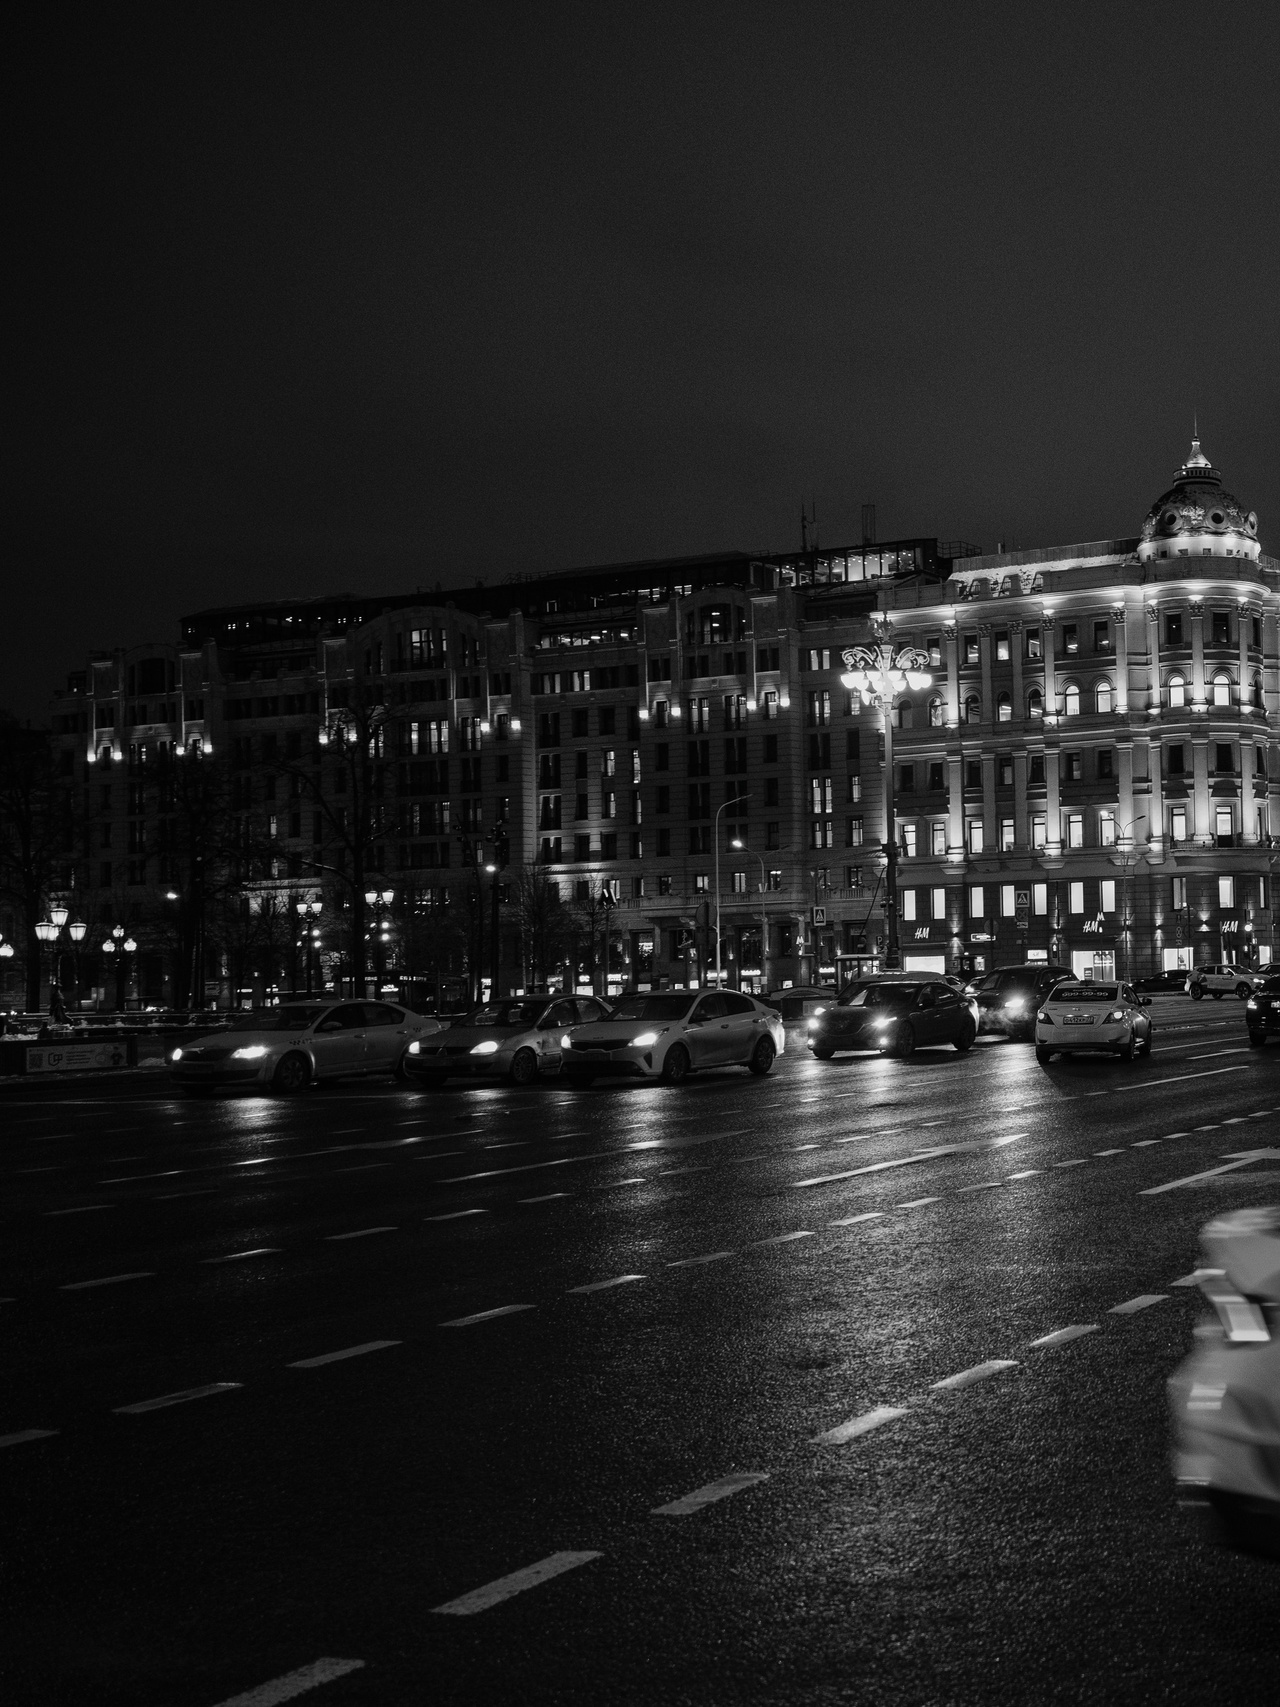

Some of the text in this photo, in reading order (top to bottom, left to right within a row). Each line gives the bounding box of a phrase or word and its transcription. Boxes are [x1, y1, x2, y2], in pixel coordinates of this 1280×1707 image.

[914, 926, 930, 939] H&M
[1082, 920, 1098, 933] H&M
[1222, 920, 1239, 933] H&M
